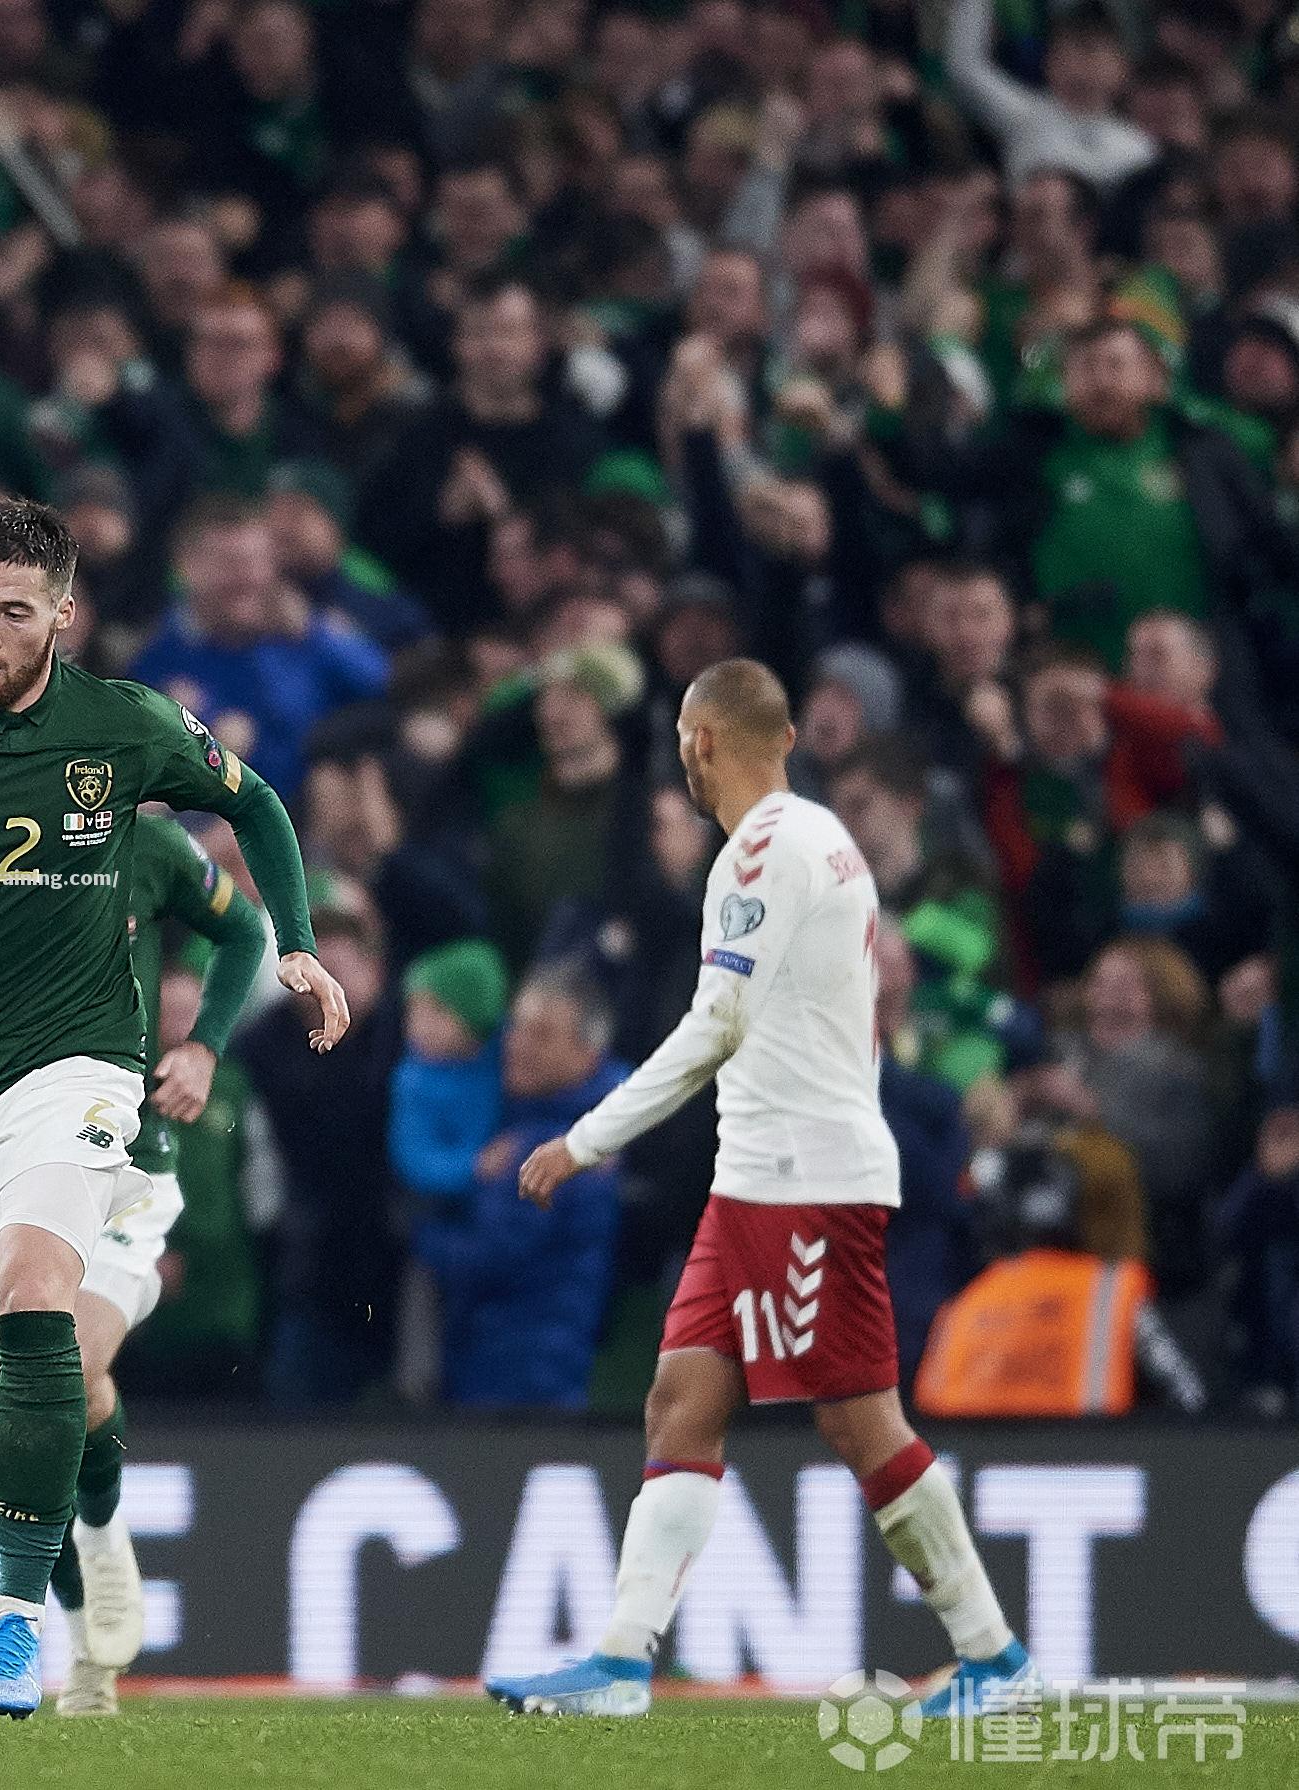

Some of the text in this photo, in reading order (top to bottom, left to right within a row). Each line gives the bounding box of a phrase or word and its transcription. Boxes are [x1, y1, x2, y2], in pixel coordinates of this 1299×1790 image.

[74, 765, 105, 775] Ireland
[733, 1289, 786, 1361] 11
[288, 1463, 1148, 1690] CANT
